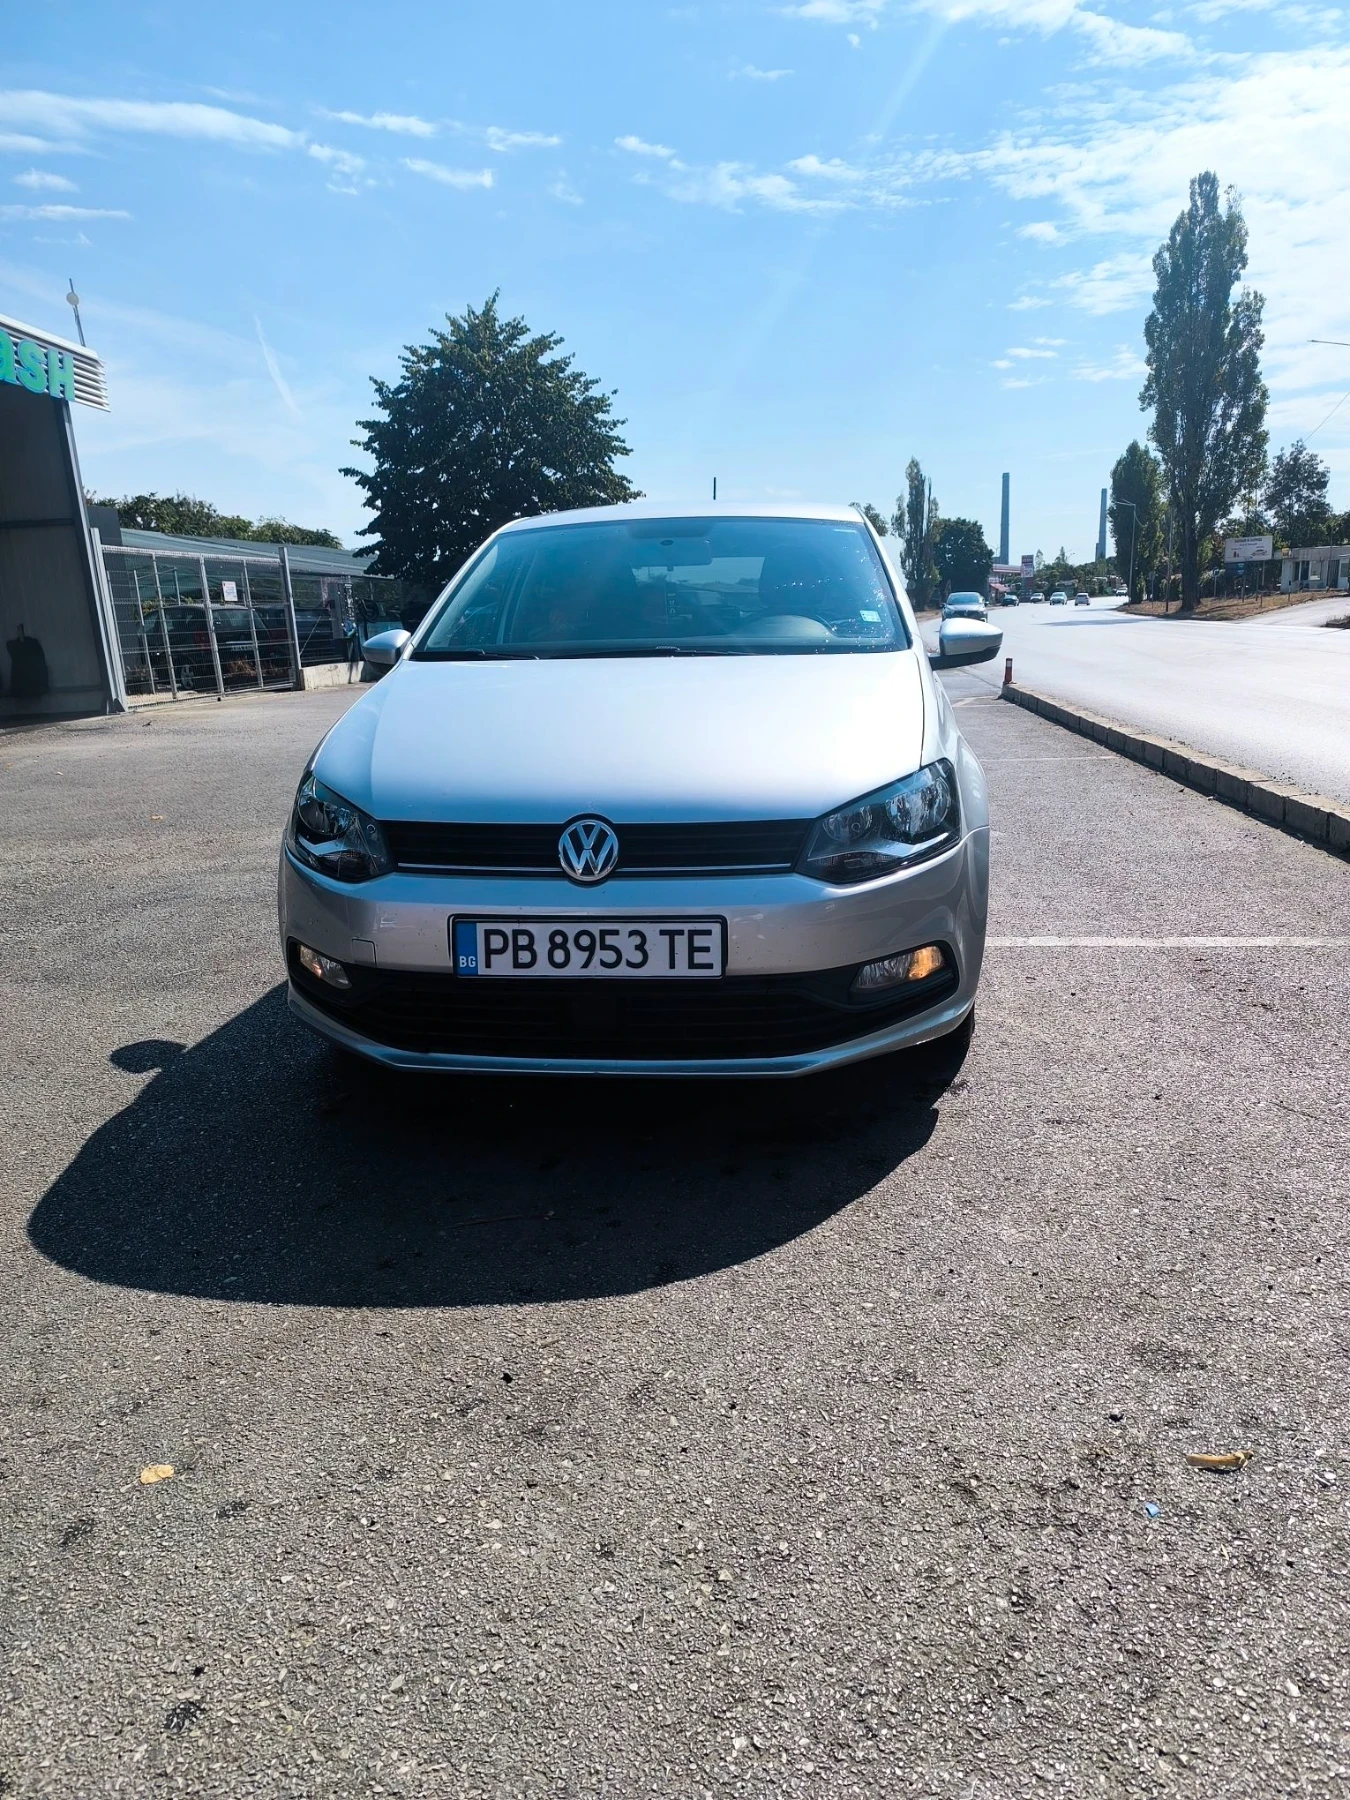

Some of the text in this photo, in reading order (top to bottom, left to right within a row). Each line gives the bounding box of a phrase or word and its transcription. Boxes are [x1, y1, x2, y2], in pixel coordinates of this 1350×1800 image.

[559, 820, 618, 881] VW
[459, 955, 477, 968] BG
[483, 928, 715, 970] PB 8953 TE
